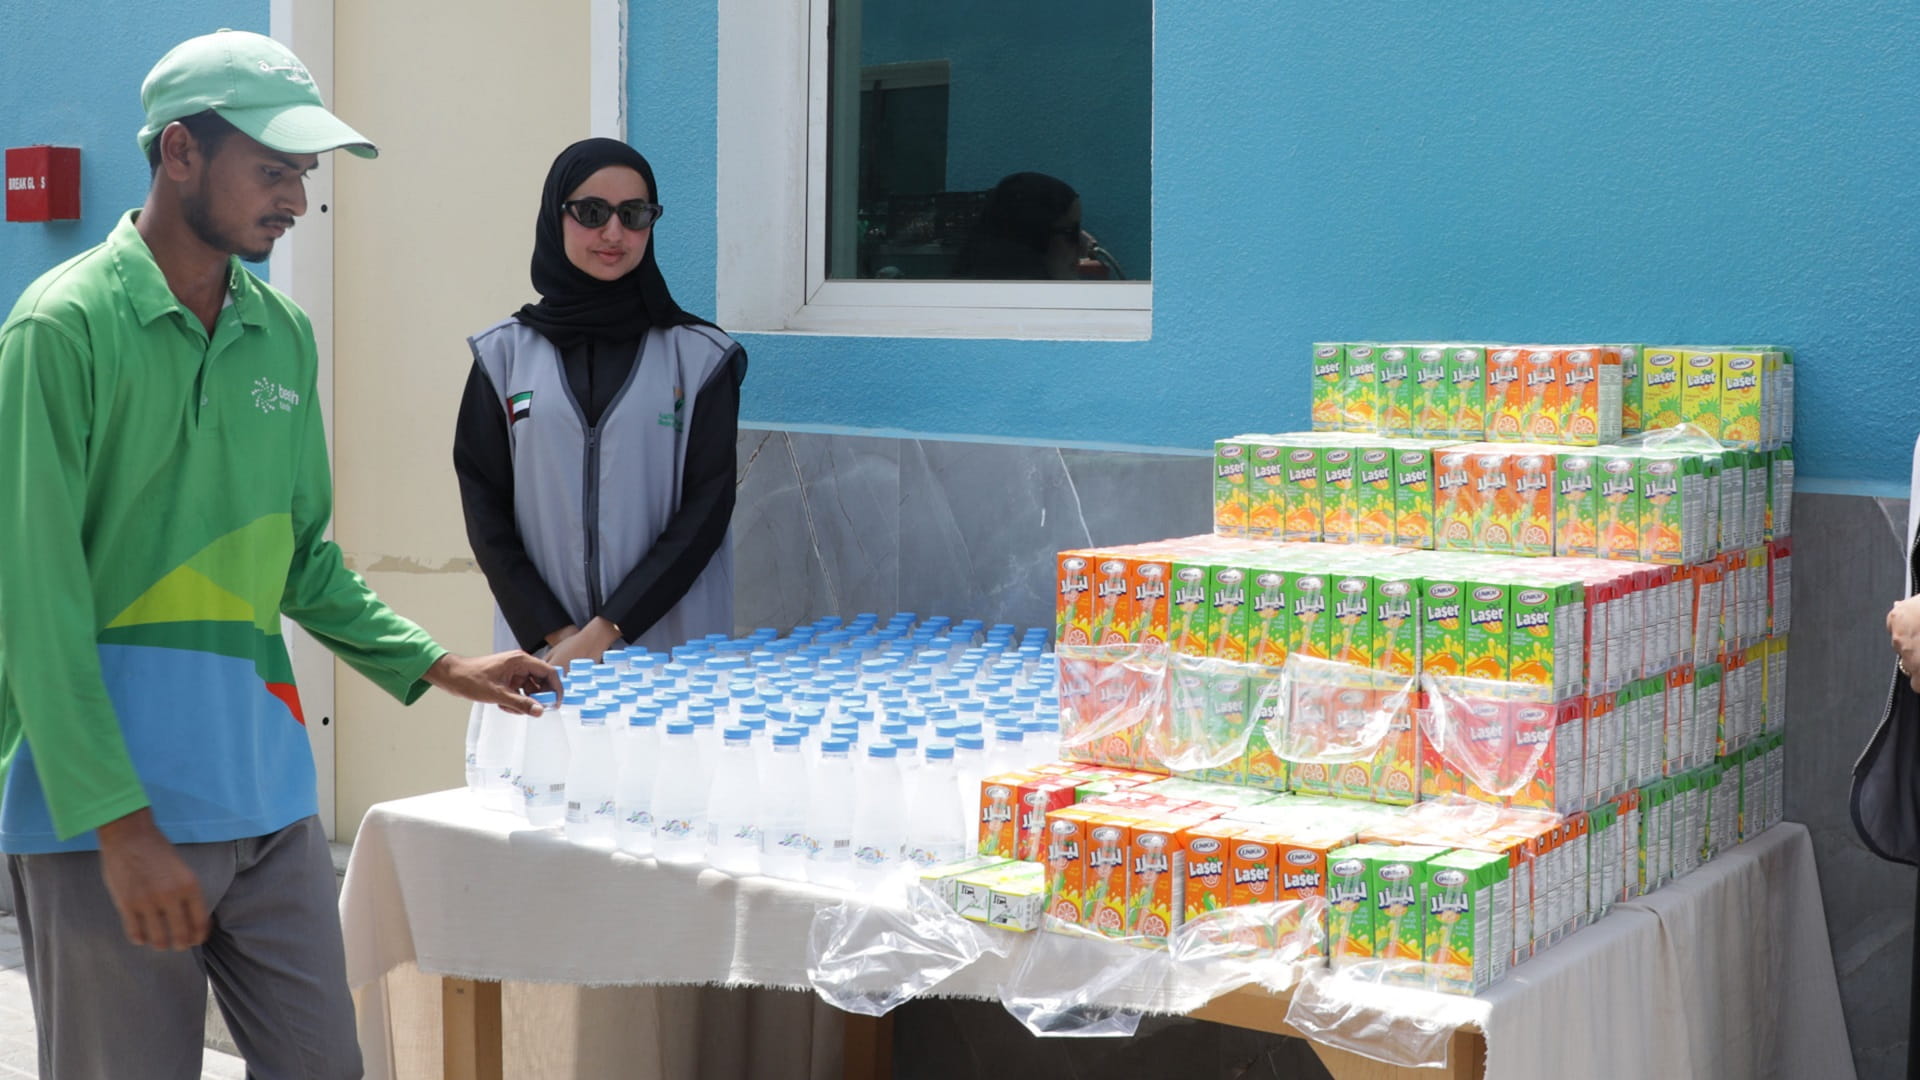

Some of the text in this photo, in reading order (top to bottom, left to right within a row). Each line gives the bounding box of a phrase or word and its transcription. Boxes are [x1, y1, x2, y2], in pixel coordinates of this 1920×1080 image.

[8, 177, 27, 190] BREAK
[1315, 362, 1340, 376] Laser
[1350, 362, 1375, 376] Laser
[1648, 371, 1676, 385] Laser
[1687, 372, 1715, 387] Laser
[1726, 375, 1757, 390] Laser
[1218, 462, 1245, 477] Laser
[1254, 463, 1281, 478] Laser
[1289, 467, 1317, 482] Laser
[1326, 466, 1352, 482] Laser
[1361, 467, 1389, 483] Laser
[1400, 469, 1427, 485] Laser
[1427, 604, 1460, 621] Laser
[1470, 607, 1504, 624] Laser
[1516, 611, 1549, 628] Laser
[1470, 725, 1503, 741] Laser
[1516, 729, 1550, 746] Laser
[1189, 861, 1223, 878] Laser
[1234, 867, 1270, 884] Laser
[1284, 873, 1320, 890] Laser
